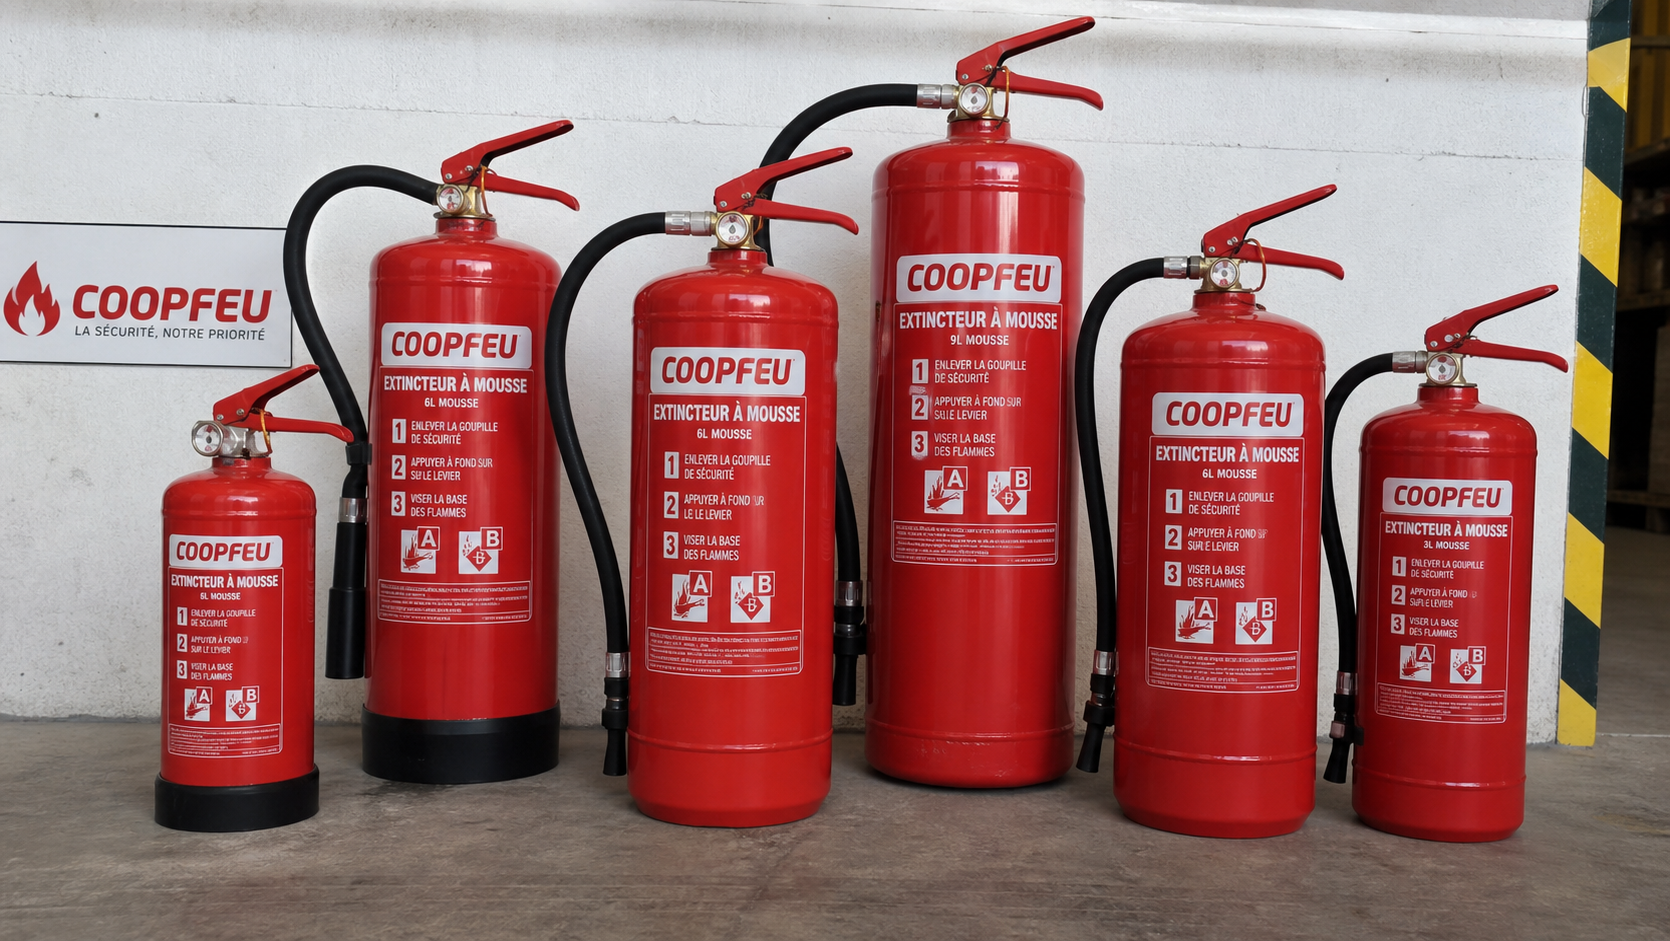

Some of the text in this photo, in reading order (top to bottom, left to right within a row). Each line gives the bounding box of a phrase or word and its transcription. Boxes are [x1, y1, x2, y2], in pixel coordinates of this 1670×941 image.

[907, 262, 1051, 292] COOPFEU
[72, 284, 272, 323] COOPFEU
[900, 306, 1057, 330] EXTINCTEUR À MOUSSE
[75, 323, 266, 341] LA SÉCURITÉ, NOTRE PRIORITÉ
[392, 331, 518, 359] COOPFEU
[950, 335, 1009, 346] 9L MOUSSE
[662, 356, 791, 386] COOPFEU
[934, 360, 1026, 371] ENLEVER LA GOUPILLE
[384, 372, 527, 393] EXTINCTEUR À MOUSSE
[934, 373, 945, 383] DE
[424, 397, 479, 408] 6L MOUSSE
[914, 397, 925, 417] 2
[934, 396, 972, 407] APPUYER
[974, 394, 980, 407] À
[983, 397, 1006, 407] FOND
[653, 400, 800, 423] EXTINCTEUR À MOUSSE
[957, 410, 987, 420] LEVIER
[1166, 401, 1292, 427] COOPFEU
[411, 421, 498, 432] ENLEVER LA GOUPILLE
[411, 433, 461, 445] DE SÉCURITÉ
[697, 428, 752, 440] 6L MOUSSE
[934, 433, 996, 444] VISER LA BASE
[914, 434, 924, 453] 3
[934, 446, 950, 457] DES
[1155, 443, 1299, 463] EXTINCTEUR À MOUSSE
[410, 457, 445, 467] APPUYER
[447, 455, 453, 467] À
[455, 457, 476, 467] FOND
[684, 454, 770, 466] ENLEVER LA GOUPILLE
[394, 458, 403, 476] 2
[684, 467, 734, 480] DE SÉCURITÉ
[433, 471, 461, 481] LEVIER
[947, 469, 1028, 487] A B
[1202, 469, 1257, 479] 6L MOUSSE
[410, 494, 467, 504] VISER LA BASE
[684, 494, 719, 505] APPUYER
[720, 492, 726, 505] À
[728, 495, 750, 506] FOND
[1188, 491, 1274, 502] ENLEVER LA GOUPILLE
[1394, 485, 1501, 508] COOPFEU
[394, 494, 403, 513] 3
[666, 495, 676, 515] 2
[1188, 504, 1240, 515] DE SÉCURITÉ
[410, 507, 466, 518] DES FLAMMES
[695, 509, 704, 520] LE
[1187, 527, 1224, 538] APPUYER
[1227, 526, 1233, 538] À
[1234, 528, 1256, 538] FOND
[1385, 520, 1508, 538] EXTINCTEUR À MOUSSE
[420, 529, 500, 547] A B
[683, 535, 740, 547] VISER LA BASE
[1168, 528, 1178, 546] 2
[176, 541, 271, 562] COOPFEU
[666, 535, 675, 555] 3
[1212, 541, 1239, 551] LEVIER
[1423, 540, 1469, 550] 3L MOUSSE
[683, 549, 739, 561] DES FLAMMES
[1187, 564, 1245, 575] VISER LA BASE
[1442, 560, 1451, 568] LA
[1168, 564, 1177, 583] 3
[1411, 569, 1419, 578] DE
[171, 573, 278, 588] EXTINCTEUR À MOUSSE
[693, 574, 771, 593] A B
[1187, 578, 1245, 589] DES FLAMMES
[211, 592, 241, 600] MOUSSE
[1394, 587, 1403, 603] 2
[1198, 600, 1273, 618] A B
[1393, 617, 1402, 632] 3
[1431, 618, 1439, 627] LA
[1441, 619, 1459, 628] BASE
[1409, 628, 1422, 636] DES
[1419, 646, 1483, 663] A B
[199, 689, 257, 702] A B
